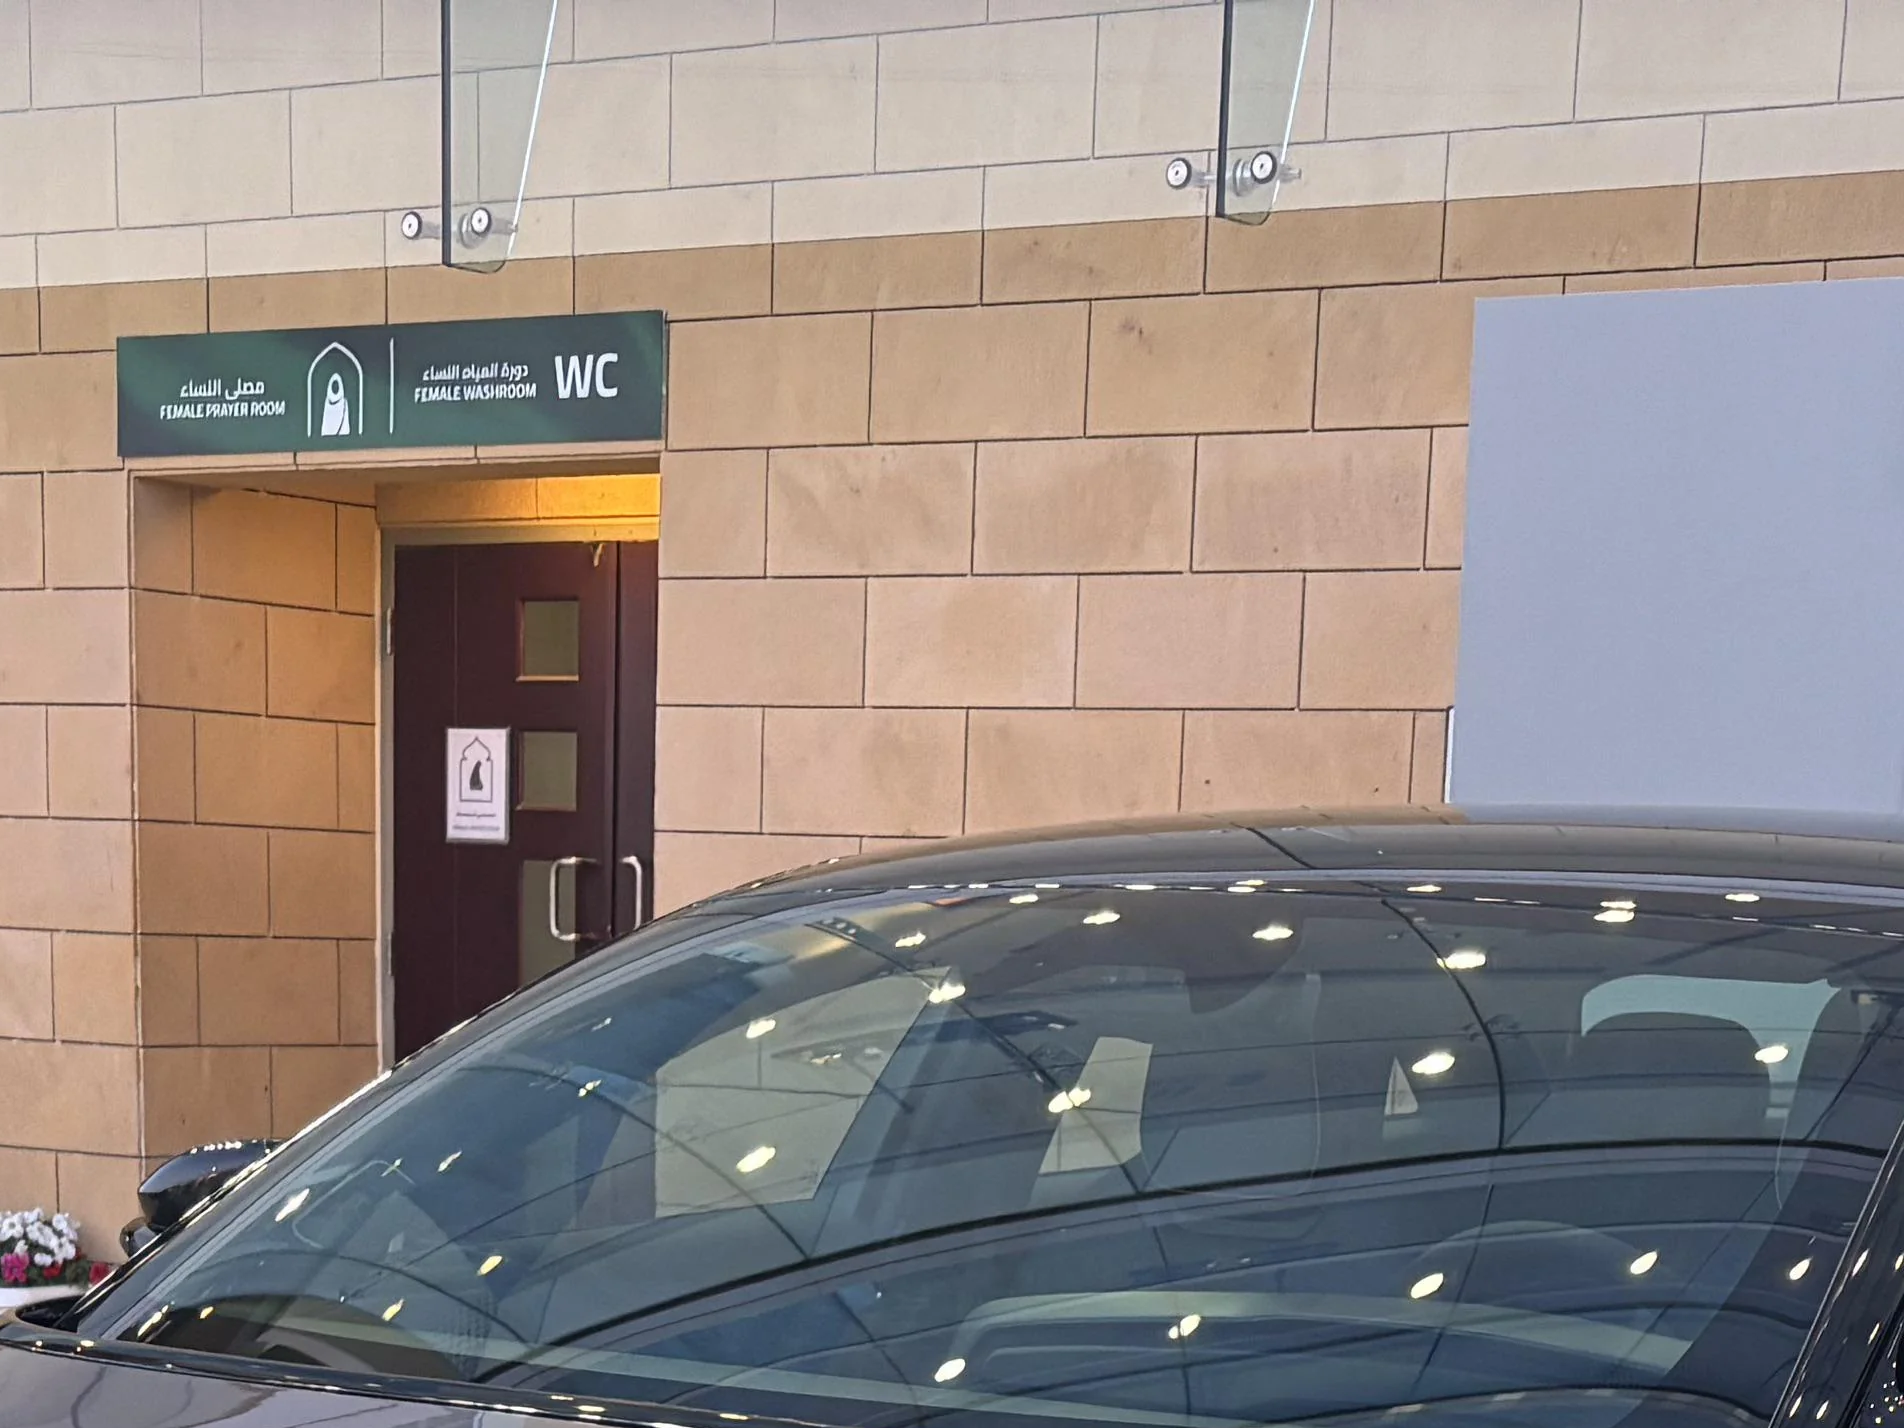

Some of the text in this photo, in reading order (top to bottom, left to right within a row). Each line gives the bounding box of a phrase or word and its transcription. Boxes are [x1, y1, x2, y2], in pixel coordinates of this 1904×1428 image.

[554, 352, 619, 399] WC
[414, 383, 537, 403] FEMALE WASHROOM
[160, 400, 286, 420] FEMALE PRAYER ROOM
